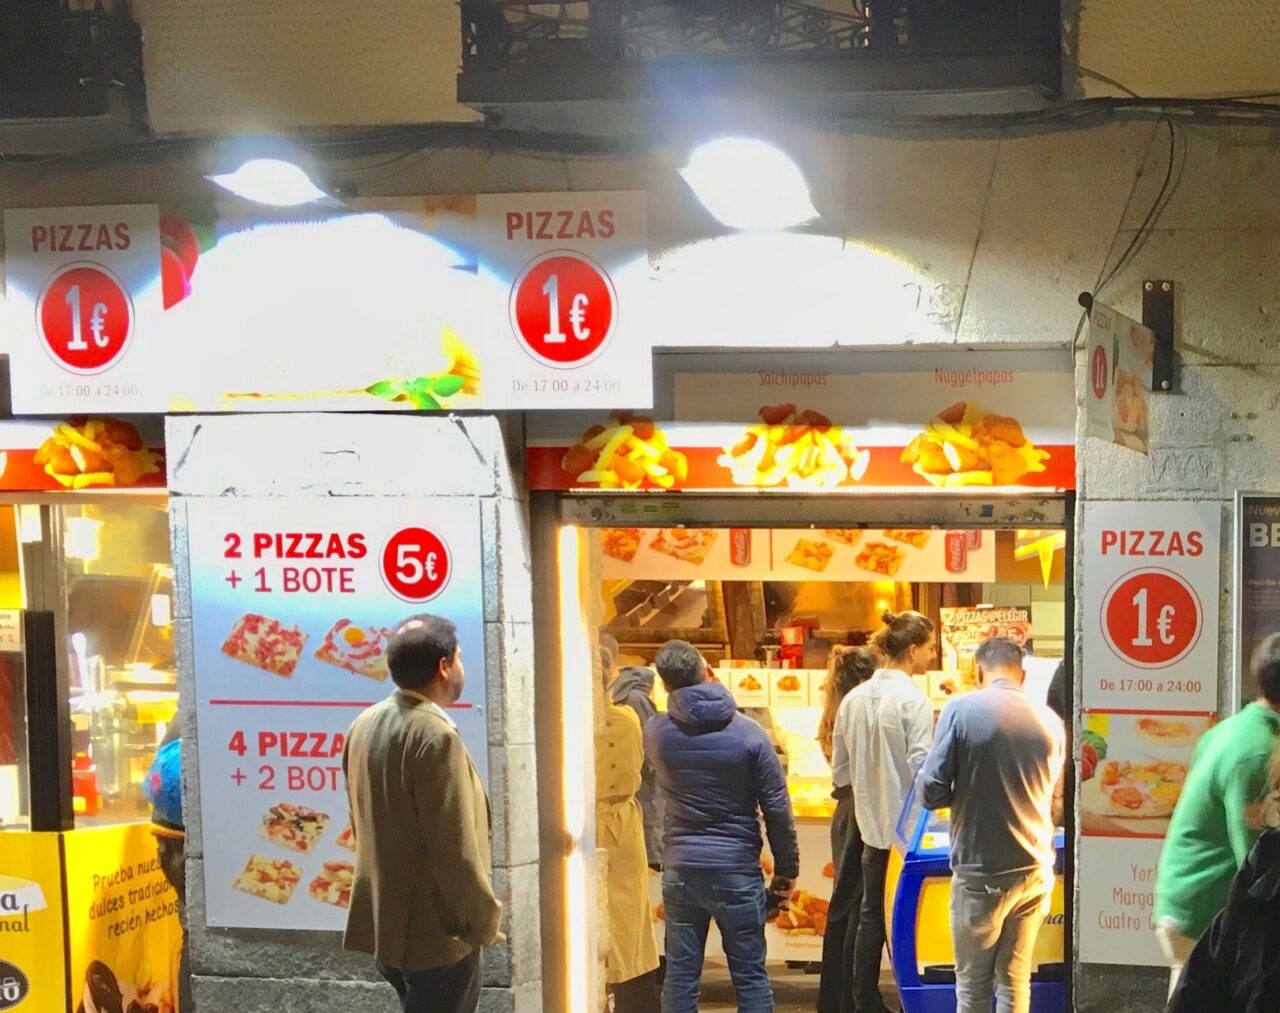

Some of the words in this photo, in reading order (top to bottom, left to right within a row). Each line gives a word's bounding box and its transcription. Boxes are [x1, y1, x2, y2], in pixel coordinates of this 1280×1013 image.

[31, 221, 131, 252] PIZZAS
[506, 209, 616, 241] PIZZAS
[65, 285, 110, 350] 1€
[541, 273, 591, 344] 1€
[512, 379, 528, 393] De
[573, 381, 580, 392] a
[758, 369, 828, 389] Salchipapas
[934, 366, 1015, 388] Nuggetpapas
[223, 533, 242, 559] 2
[253, 532, 368, 559] PIZZAS
[1101, 529, 1204, 557] PIZZAS
[395, 544, 438, 585] 5€
[254, 567, 272, 592] 1
[283, 567, 356, 593] BOTE
[1131, 587, 1176, 647] 1€
[1100, 678, 1115, 691] De
[1119, 679, 1152, 692] 17:00
[1156, 682, 1164, 692] a
[1167, 680, 1202, 693] 24:00
[228, 730, 247, 757] 4
[258, 731, 344, 758] PIZZA
[258, 766, 276, 790] 2
[288, 766, 342, 792] BOT
[92, 864, 134, 893] Prueba
[137, 857, 161, 876] nues
[89, 893, 125, 920] dulces
[128, 879, 173, 905] tradicio
[1112, 887, 1154, 910] Marga
[107, 909, 142, 940] recién
[1098, 910, 1141, 931] Cuatro
